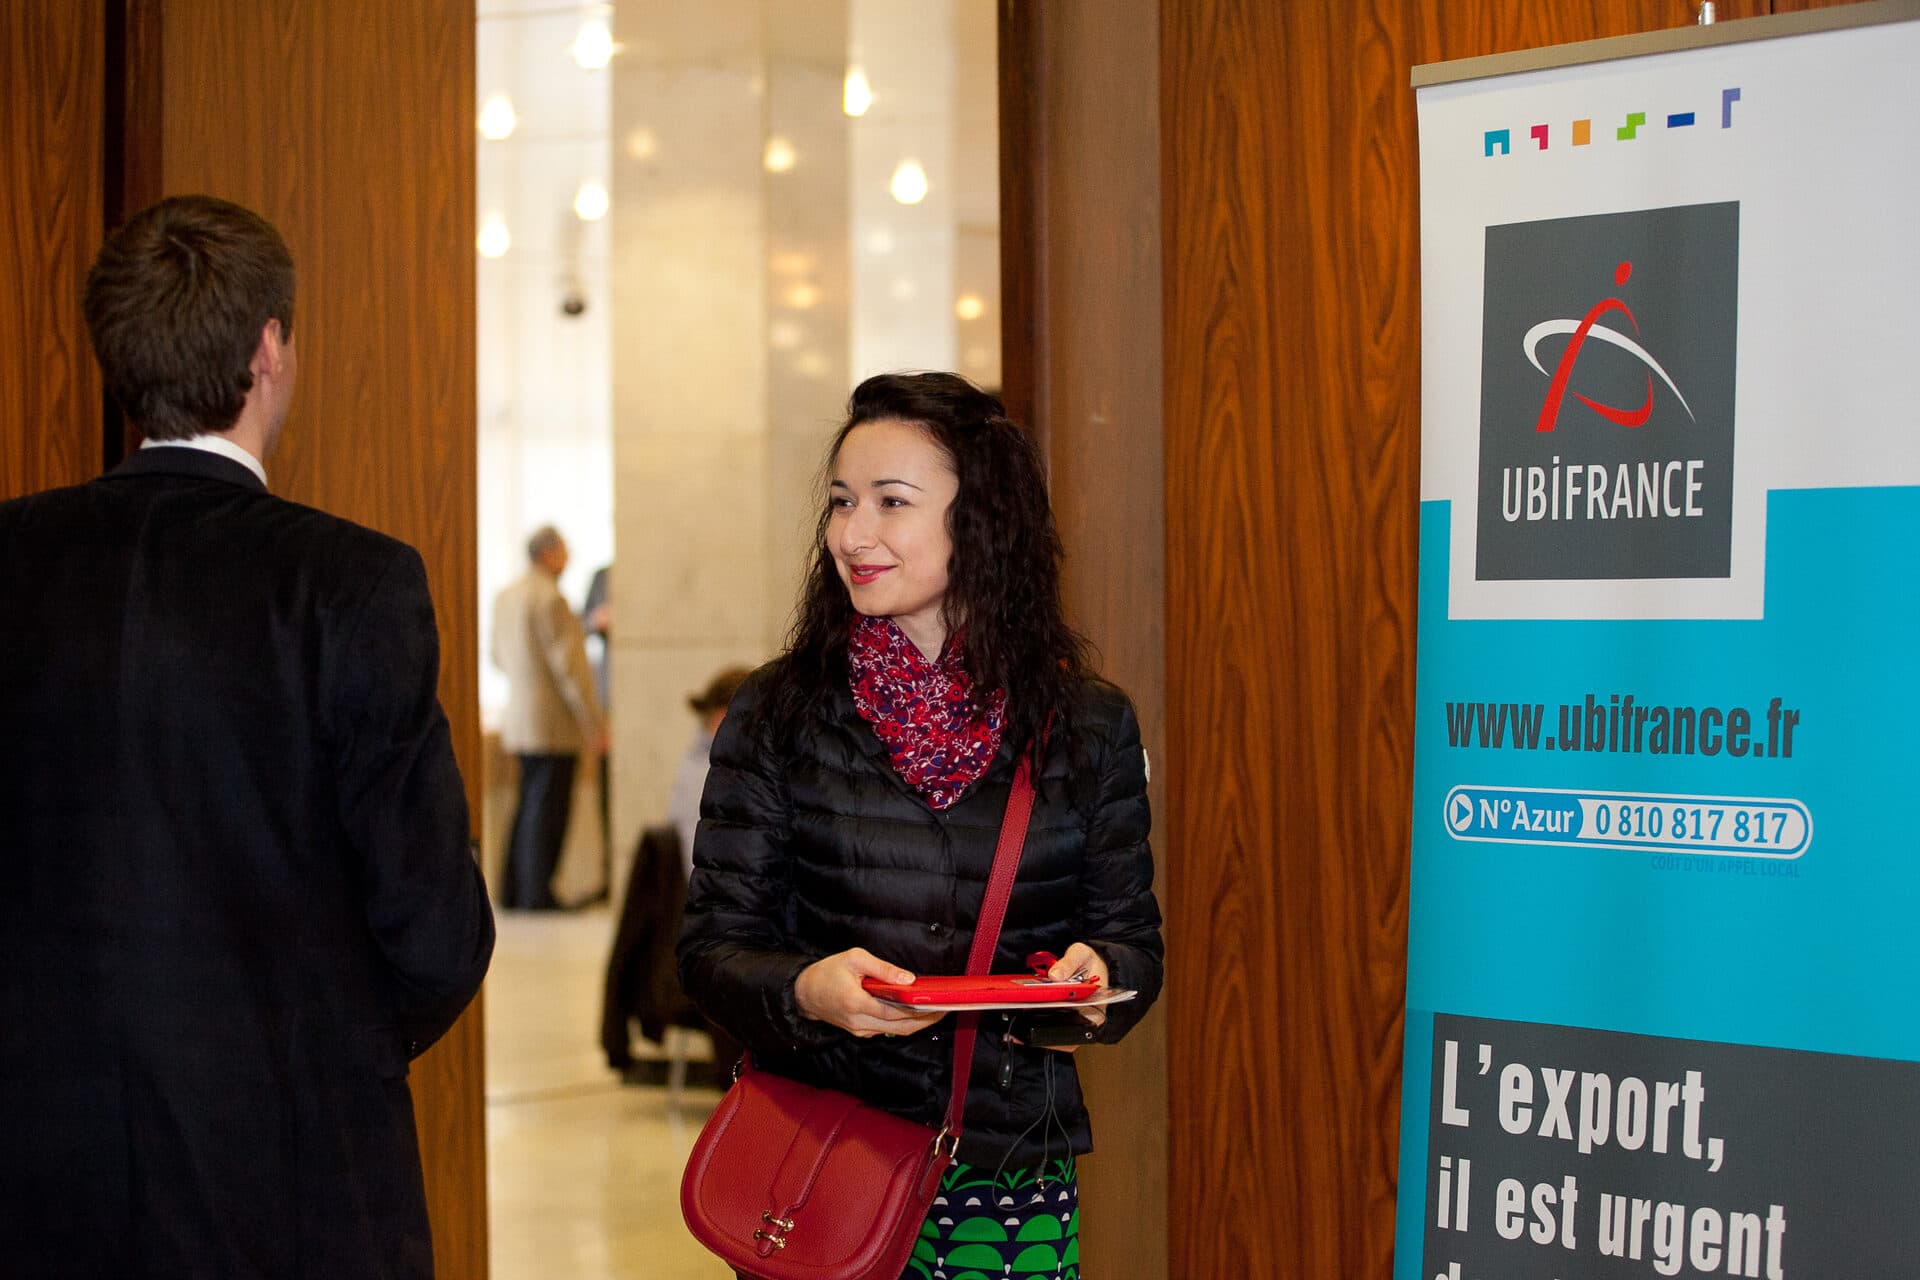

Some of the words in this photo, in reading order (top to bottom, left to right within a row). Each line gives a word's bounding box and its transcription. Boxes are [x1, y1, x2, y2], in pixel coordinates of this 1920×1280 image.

[1446, 694, 1800, 758] www.ubifrance.fr
[1595, 804, 1611, 835] 0
[1618, 804, 1663, 838] 810
[1671, 808, 1725, 841] 817
[1733, 810, 1788, 844] 817
[1718, 859, 1757, 876] APPEL
[1760, 862, 1800, 879] LOCAL
[1437, 1155, 1471, 1232] il
[1495, 1175, 1578, 1250] est
[1599, 1193, 1786, 1280] urgent
